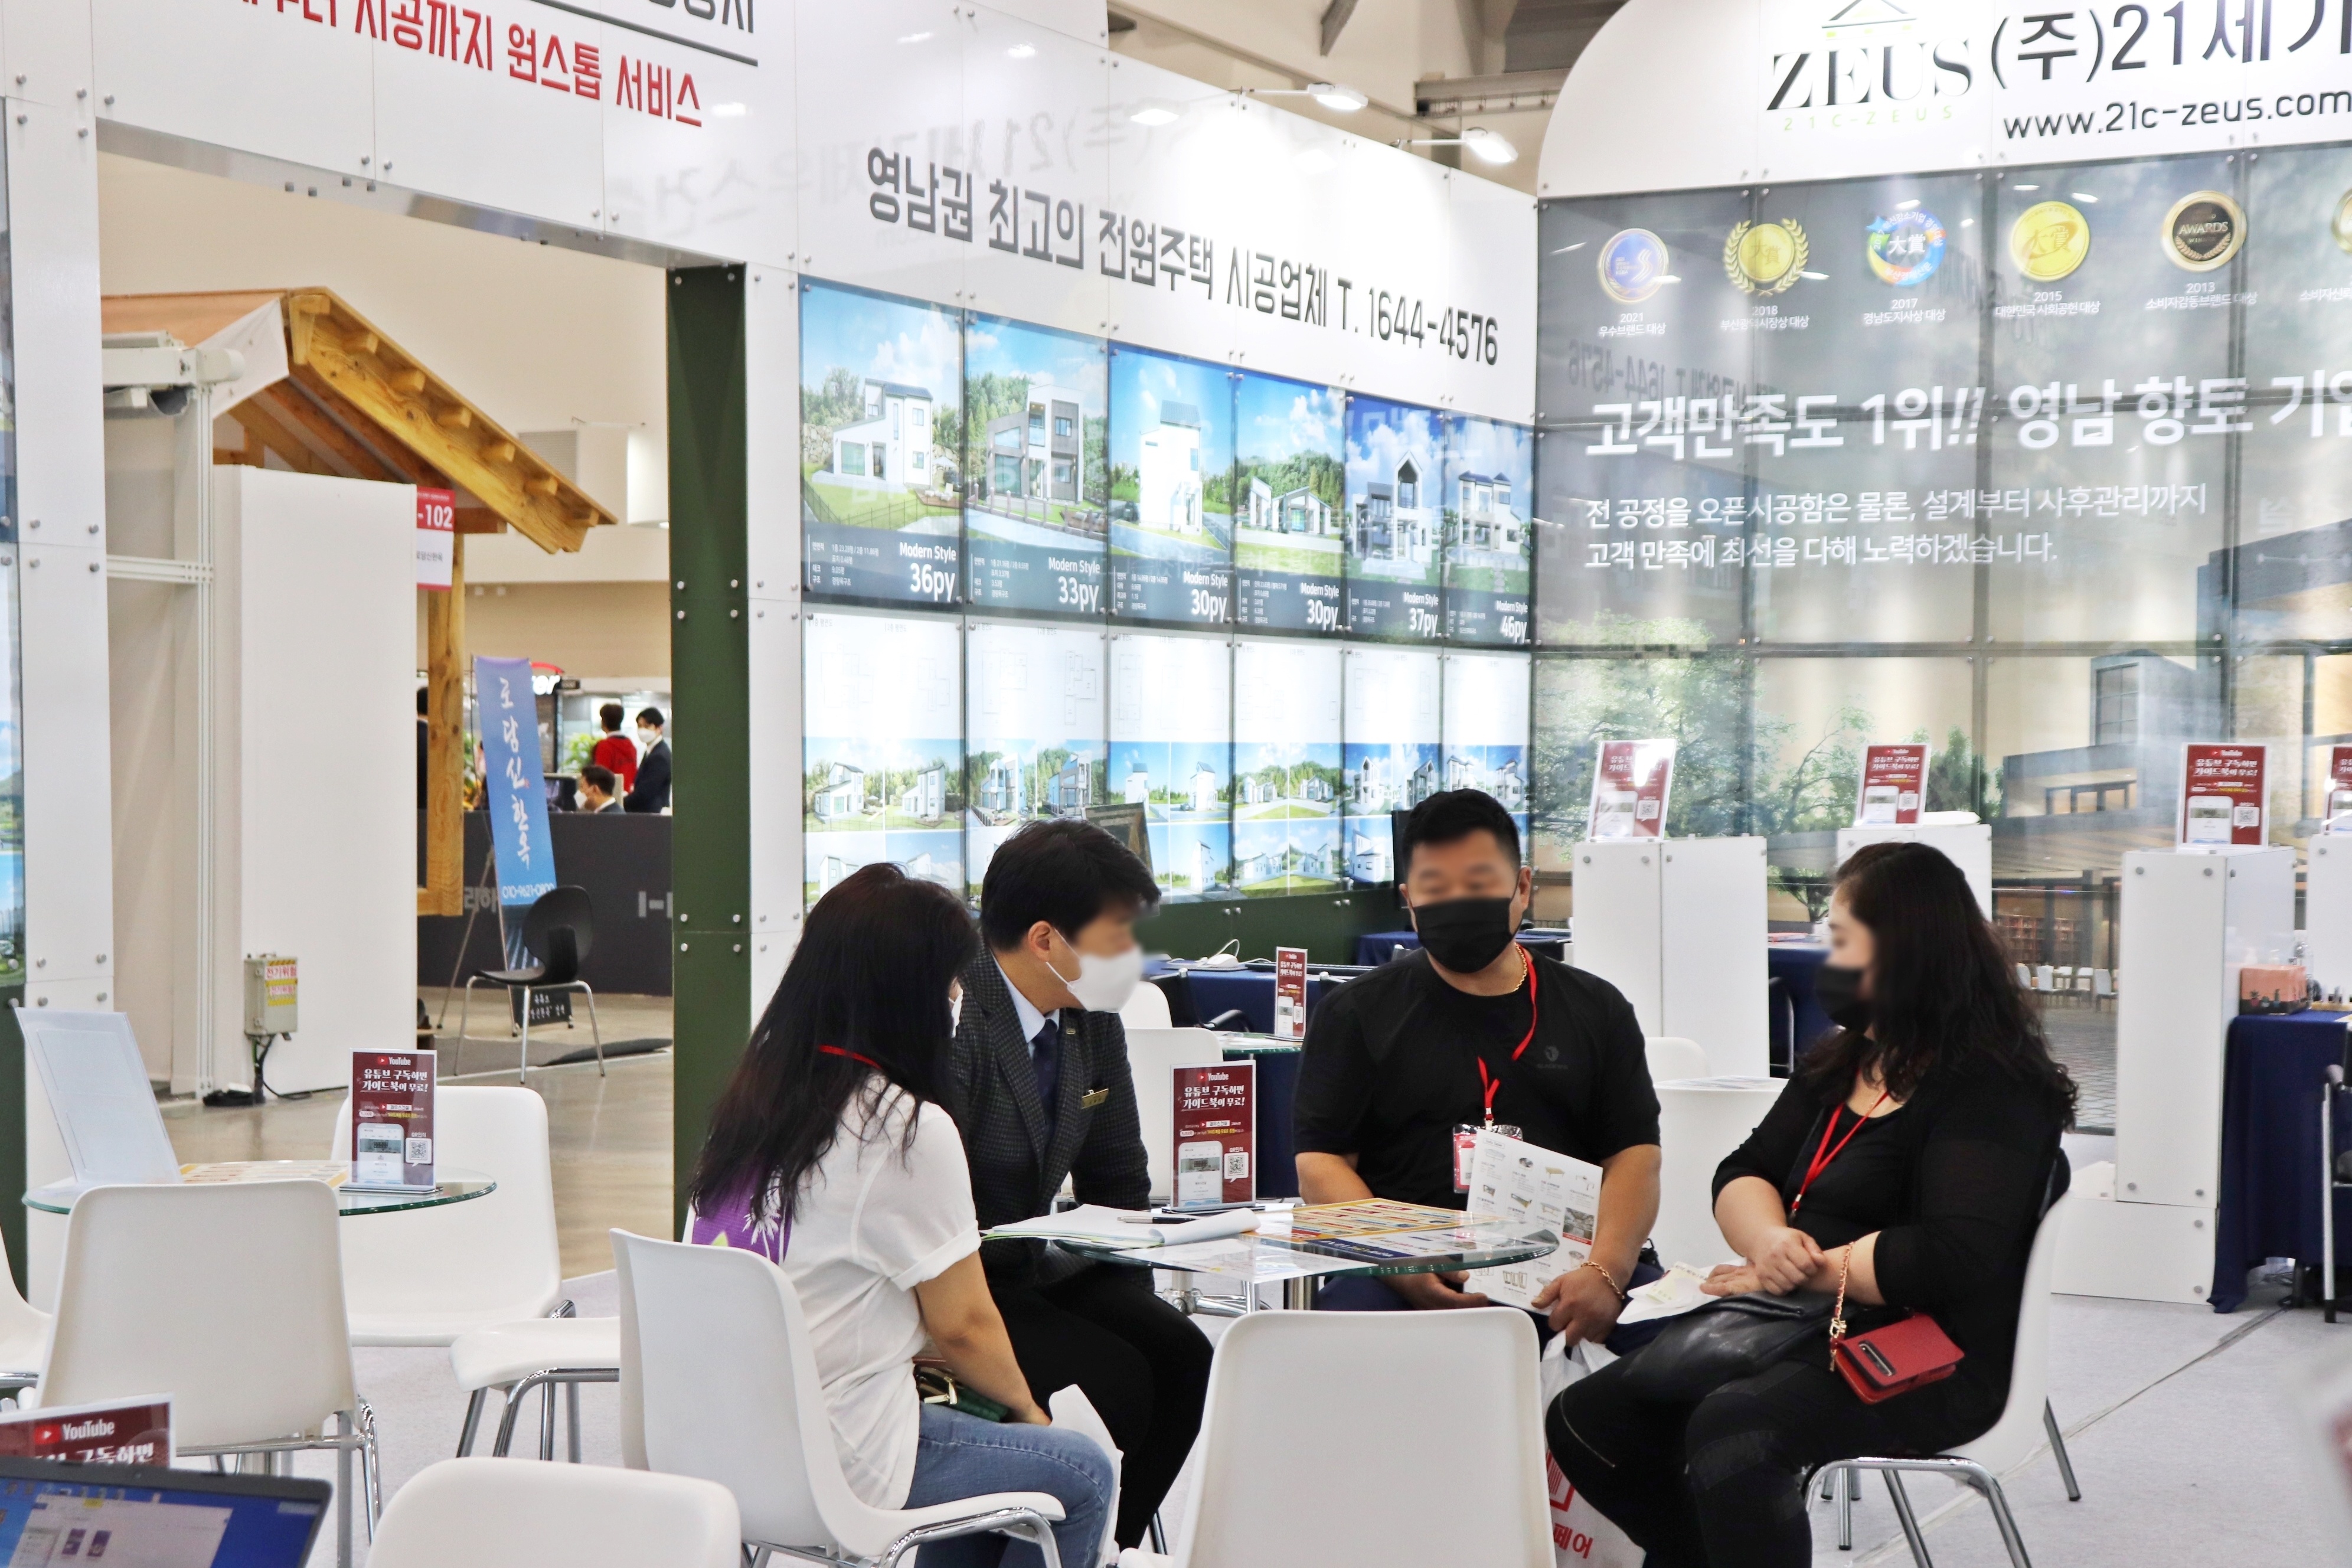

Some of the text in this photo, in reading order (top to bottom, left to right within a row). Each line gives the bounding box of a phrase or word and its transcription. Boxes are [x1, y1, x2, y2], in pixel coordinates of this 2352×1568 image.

[355, 0, 703, 127] 시공까지 원스톱 서비스
[1767, 38, 1974, 110] ZEUS
[1784, 106, 1952, 131] 21C-ZEUS
[2004, 90, 2352, 139] www.21c-zeus.com
[2178, 221, 2229, 235] AWARDS
[1889, 233, 1926, 254] 大賞
[868, 146, 973, 243] 영남권
[989, 179, 1084, 269] 최고의
[1099, 210, 1213, 300] 전원주택
[1227, 246, 1328, 328] 시공업체
[1338, 276, 1358, 333] T.
[1369, 286, 1498, 365] 1644-4576
[2034, 290, 2063, 302] 2015
[2186, 282, 2216, 293] 2013
[1752, 305, 1778, 316] 2018
[1892, 298, 1919, 309] 2017
[1995, 300, 2101, 318] 대한민국 사회공헌 대상
[2145, 293, 2232, 310] 소비자감동브랜드
[1620, 312, 1644, 324] 2021
[1720, 314, 1809, 331] 부산광역시장상 대상
[1864, 309, 1946, 325] 경남도지사상 대상
[1599, 322, 1667, 337] 우수브랜드 대상
[1586, 394, 1845, 460] 고객만족도
[1860, 385, 1987, 451] 1위!!
[2008, 378, 2124, 449] 영남
[2134, 375, 2253, 445] 향토
[1586, 498, 1611, 528] 전
[1616, 496, 1692, 529] 공정을
[1856, 491, 1916, 522] 물론,
[1922, 488, 2030, 520] 설계부터
[2037, 483, 2207, 518] 사후관리까지
[899, 541, 957, 563] Modern Style
[1586, 531, 2059, 570] 고객 만족에 최선을 다해 노력하겠습니다.
[1048, 556, 1101, 576] Modern Style
[910, 562, 956, 602] 36py
[1183, 570, 1229, 589] Modern Style
[1058, 576, 1100, 612] 33py
[1301, 582, 1340, 599] Modern Style
[1404, 592, 1439, 607] Modern Style
[1191, 589, 1228, 623] 30py
[1306, 599, 1339, 631] 30py
[1495, 600, 1528, 615] Modern Style
[1409, 607, 1439, 638] 37py
[1500, 615, 1527, 644] 46py
[388, 1057, 411, 1066] YouTube
[364, 1069, 428, 1081] 유튜브 구독하면
[1207, 1072, 1229, 1081] YouTube
[362, 1080, 429, 1093] 가이드북이 무료!
[1184, 1084, 1244, 1097] 유튜브 구독하면
[1182, 1097, 1246, 1109] 가이드북이 무료!
[62, 1419, 115, 1440] YouTube
[1553, 1523, 1593, 1559] 페어
